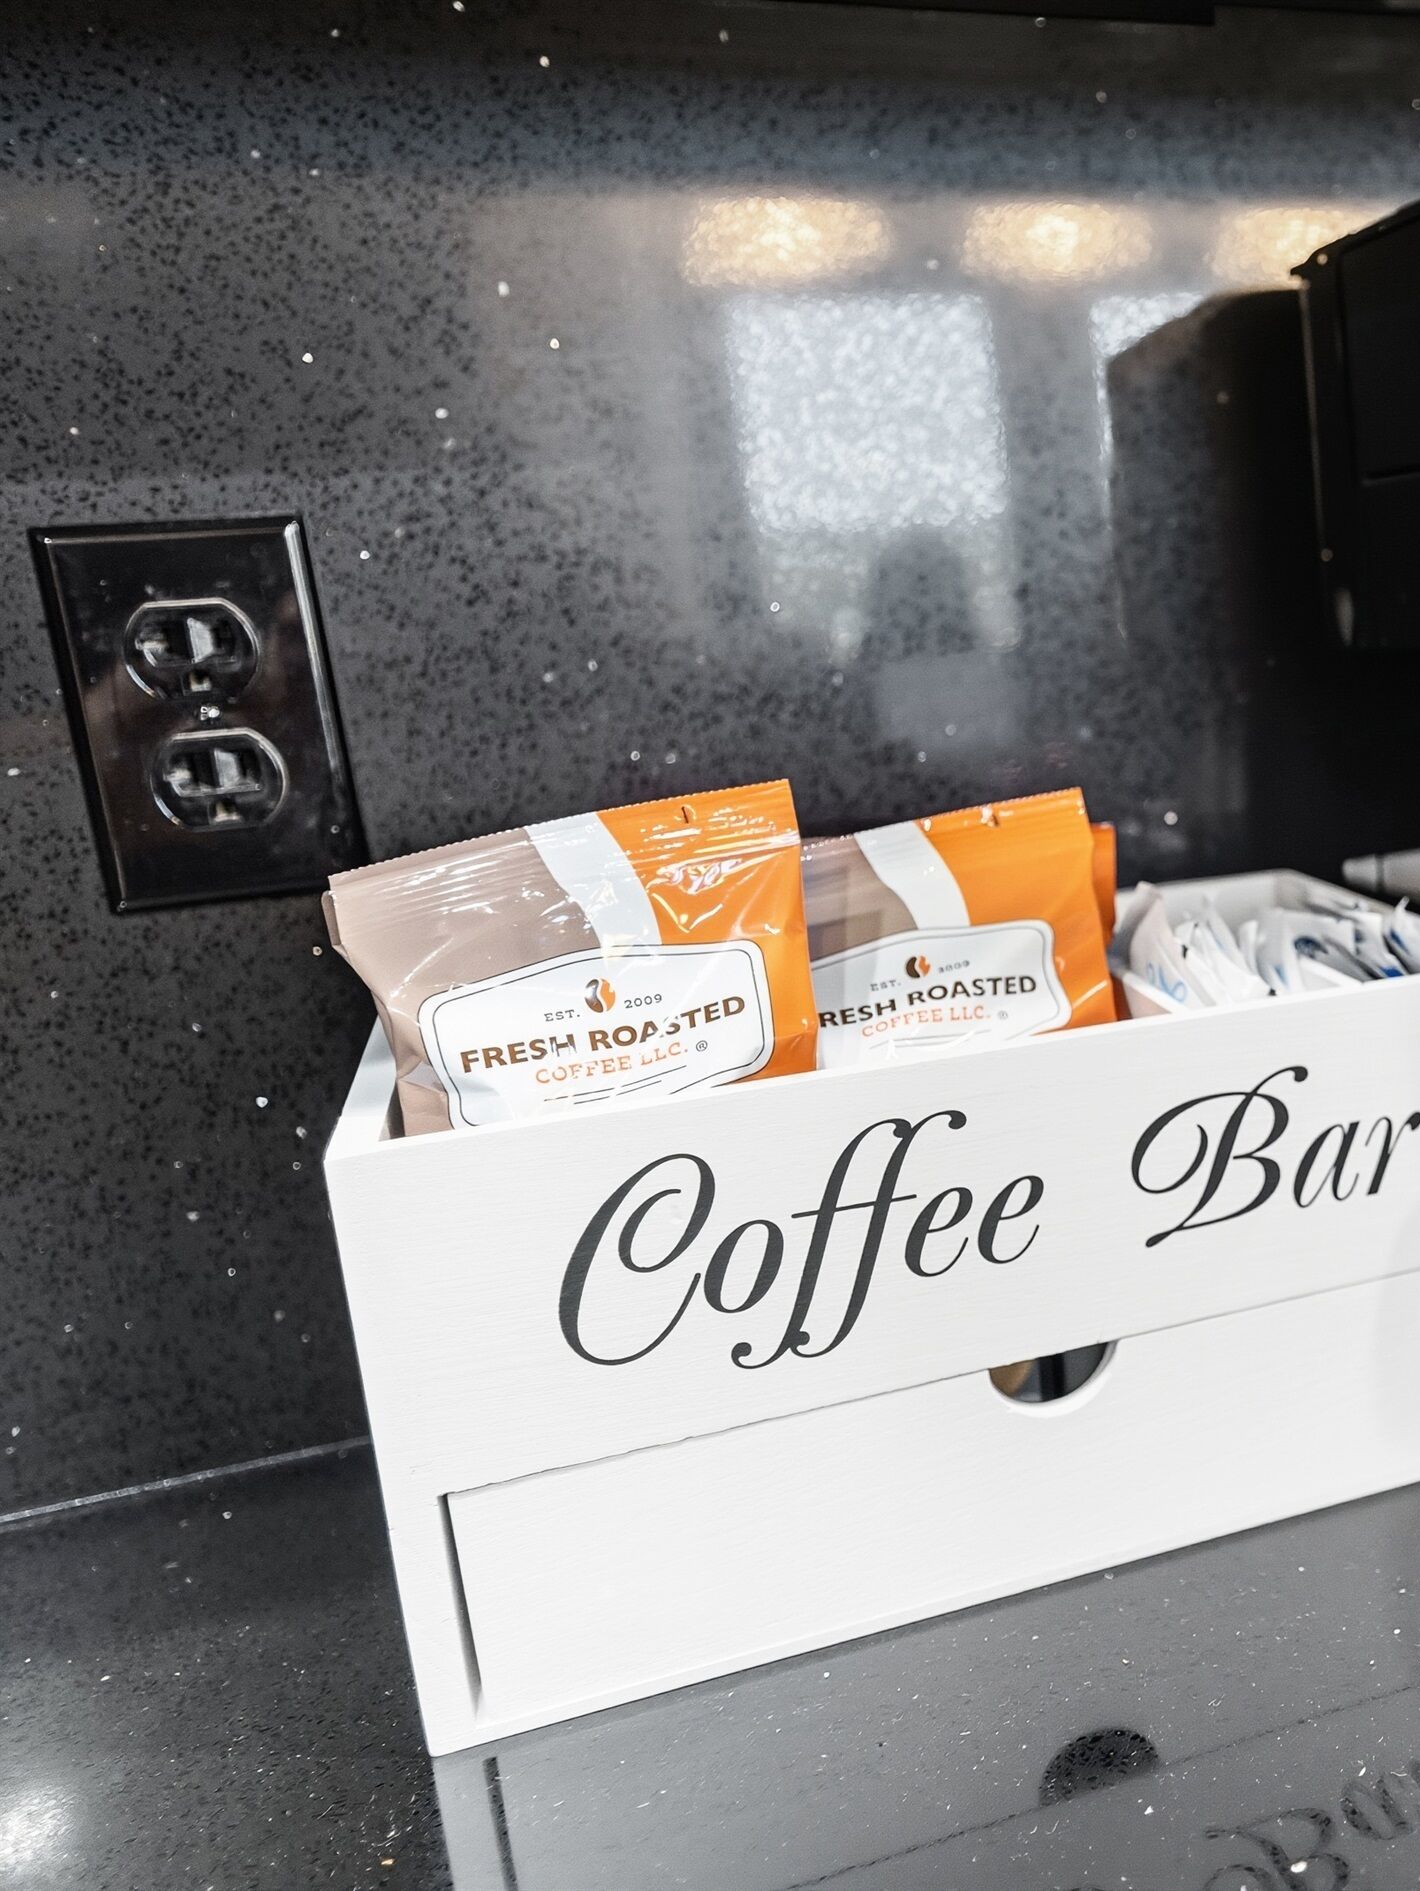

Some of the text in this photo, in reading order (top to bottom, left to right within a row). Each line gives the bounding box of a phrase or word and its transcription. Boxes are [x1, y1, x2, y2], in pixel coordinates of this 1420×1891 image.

[818, 975, 1037, 1028] RESH ROASTED
[870, 979, 902, 992] EST.
[543, 993, 663, 1022] EST. 2009
[861, 1005, 991, 1038] COFFEE LLC.
[460, 995, 746, 1073] FRESH ROASTED
[535, 1042, 688, 1084] COFFEE LLC.
[557, 1109, 1045, 1370] Coffee
